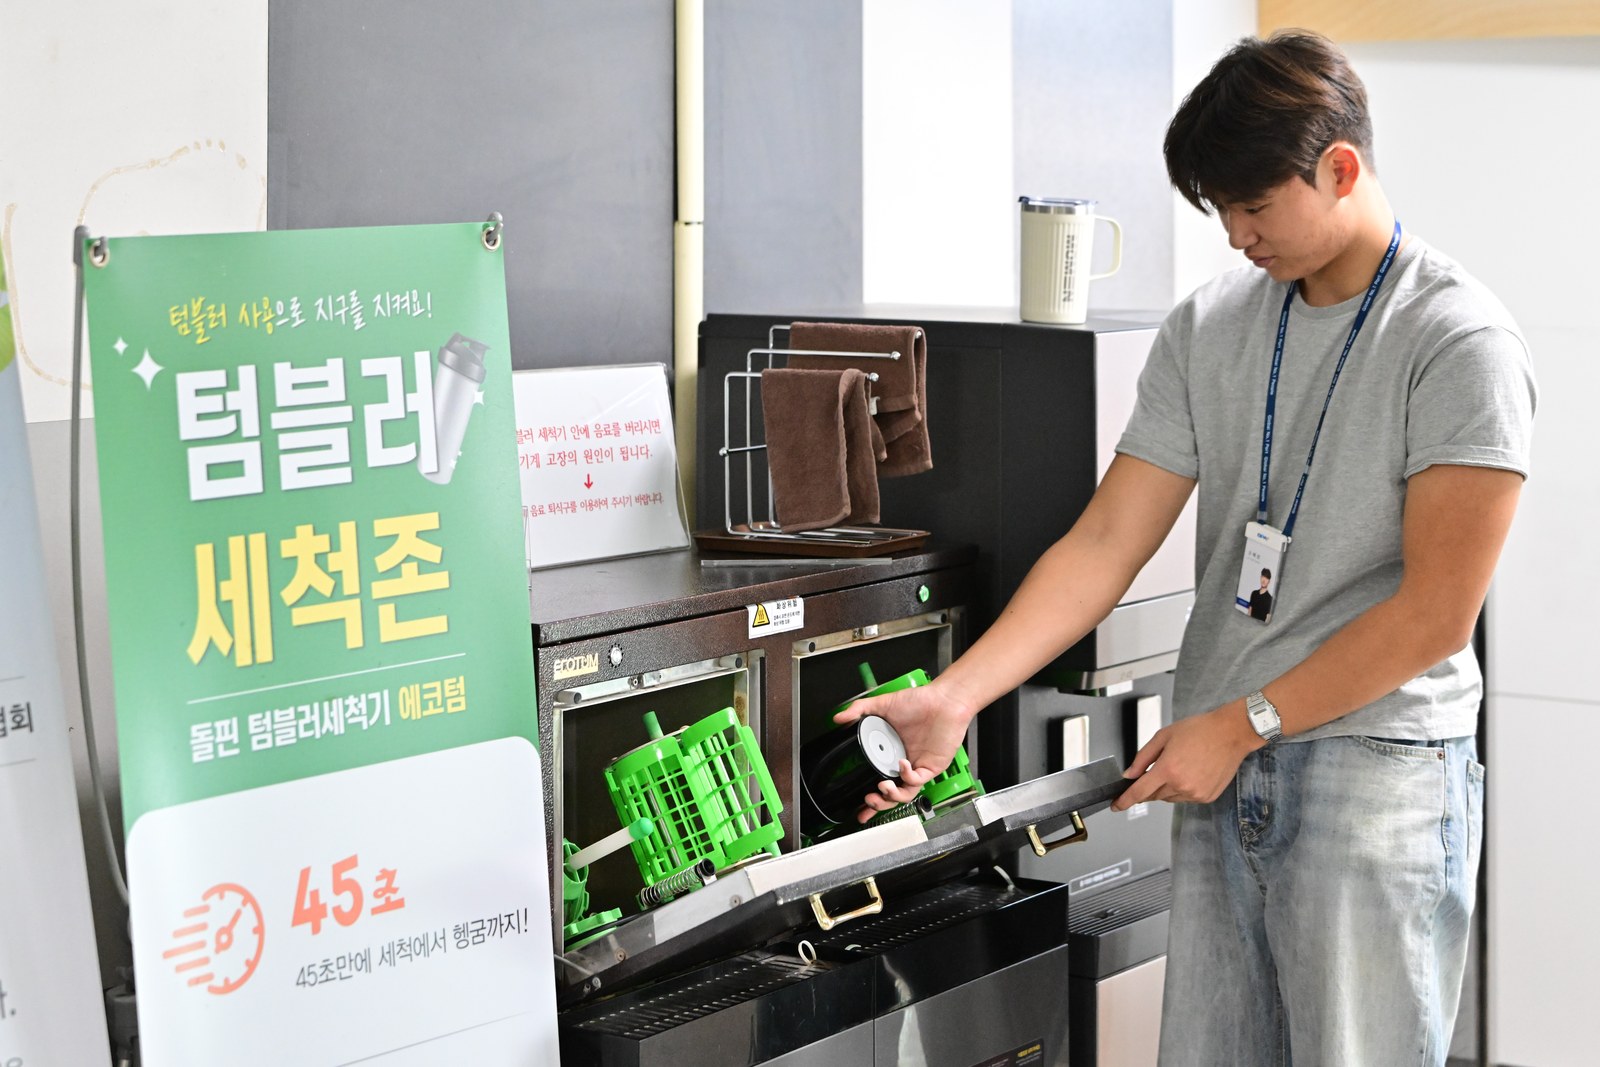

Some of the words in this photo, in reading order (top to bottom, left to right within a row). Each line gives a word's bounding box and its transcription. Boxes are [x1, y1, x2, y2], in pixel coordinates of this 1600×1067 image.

[168, 296, 228, 345] 텀블러
[238, 294, 306, 336] 사용으로
[314, 289, 367, 331] 지구를
[373, 289, 434, 321] 지켜요!
[175, 350, 440, 501] 텀블러
[519, 453, 541, 470] 기계
[546, 449, 578, 467] 고장의
[583, 447, 614, 465] 원인이
[619, 444, 653, 462] 됩니다.
[537, 425, 568, 443] 세척기
[570, 423, 591, 440] 안에
[593, 421, 622, 439] 음료를
[624, 418, 662, 436] 버리시면
[530, 504, 546, 517] 음료
[548, 500, 578, 515] 퇴식구를
[579, 496, 609, 512] 이용하여
[611, 494, 633, 509] 주시기
[185, 511, 451, 668] 세척존
[189, 716, 241, 764] 돌핀
[247, 689, 392, 752] 텀블러세척기
[398, 675, 467, 721] 에코텀
[290, 853, 406, 936] 45초
[295, 946, 373, 988] 45초만에
[378, 926, 448, 968] 세척에서
[452, 907, 529, 950] 헹굼까지!
